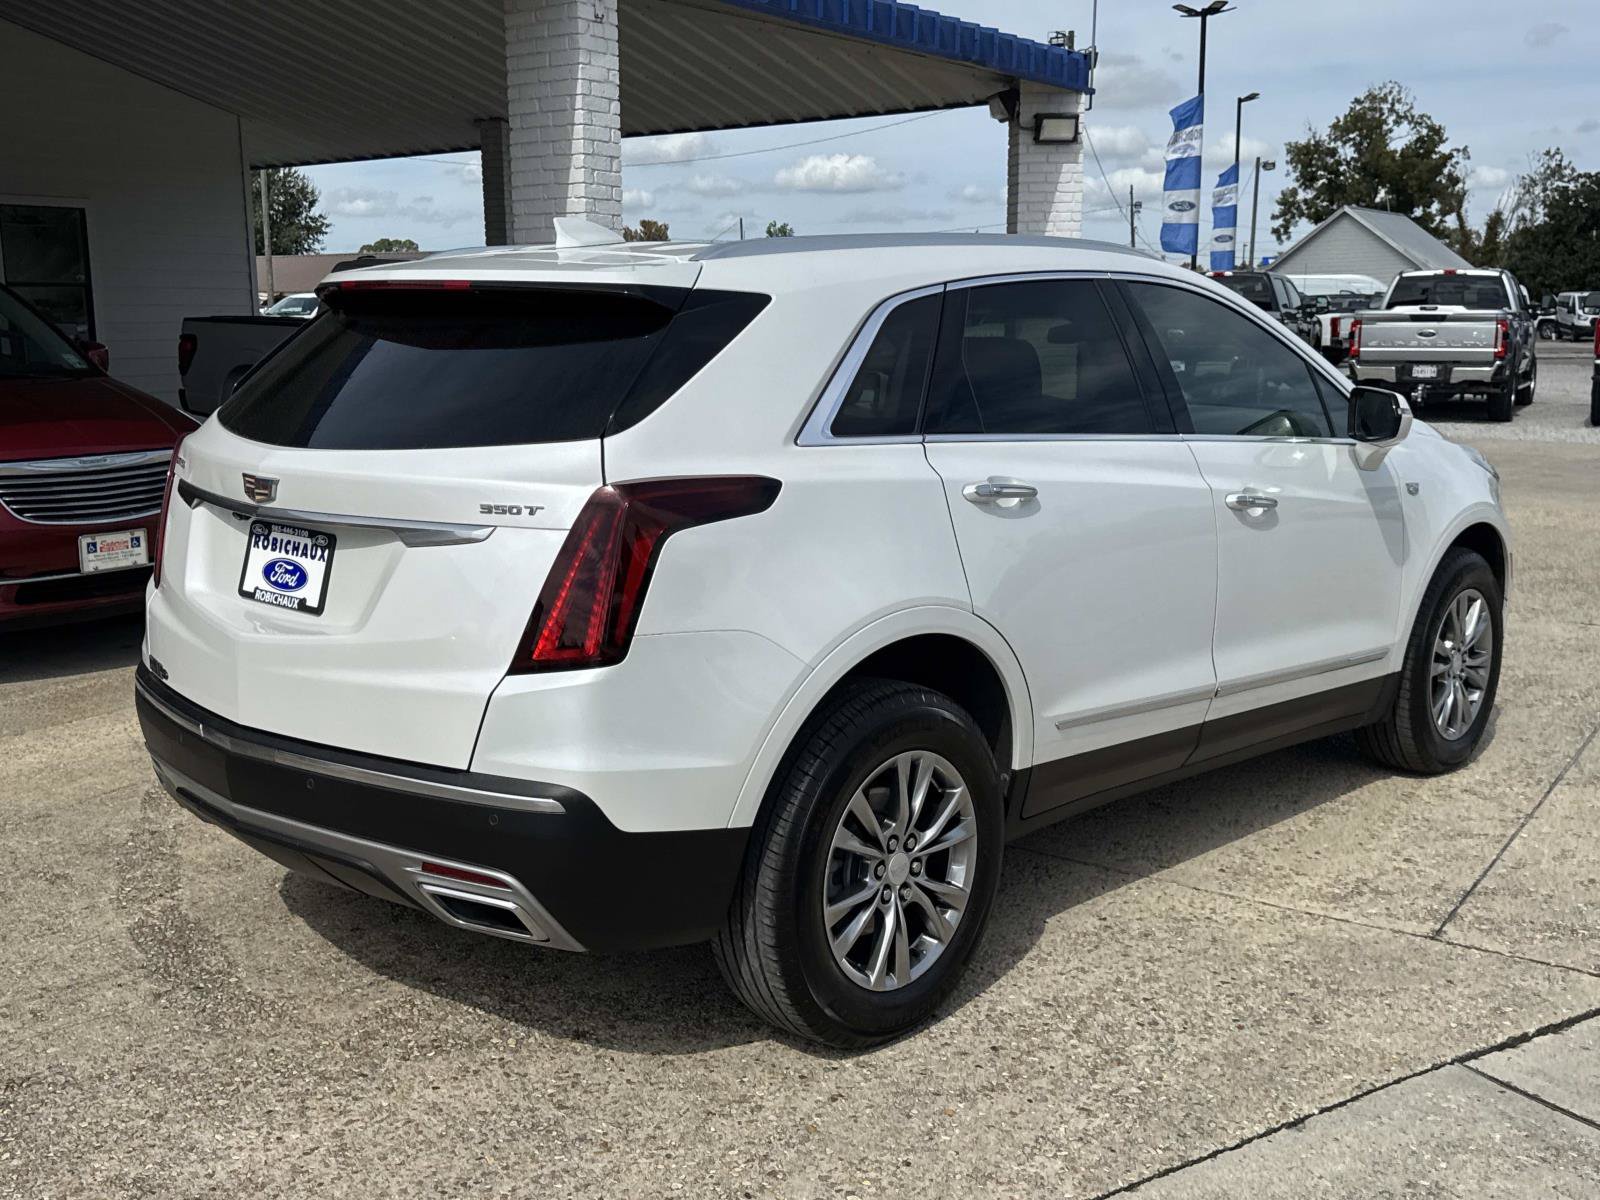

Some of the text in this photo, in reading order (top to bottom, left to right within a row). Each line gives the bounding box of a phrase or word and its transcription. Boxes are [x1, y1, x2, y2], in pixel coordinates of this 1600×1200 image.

[253, 534, 328, 562] ROBICHAUX
[270, 562, 300, 587] Ford
[254, 589, 300, 609] ROBICHAUX
